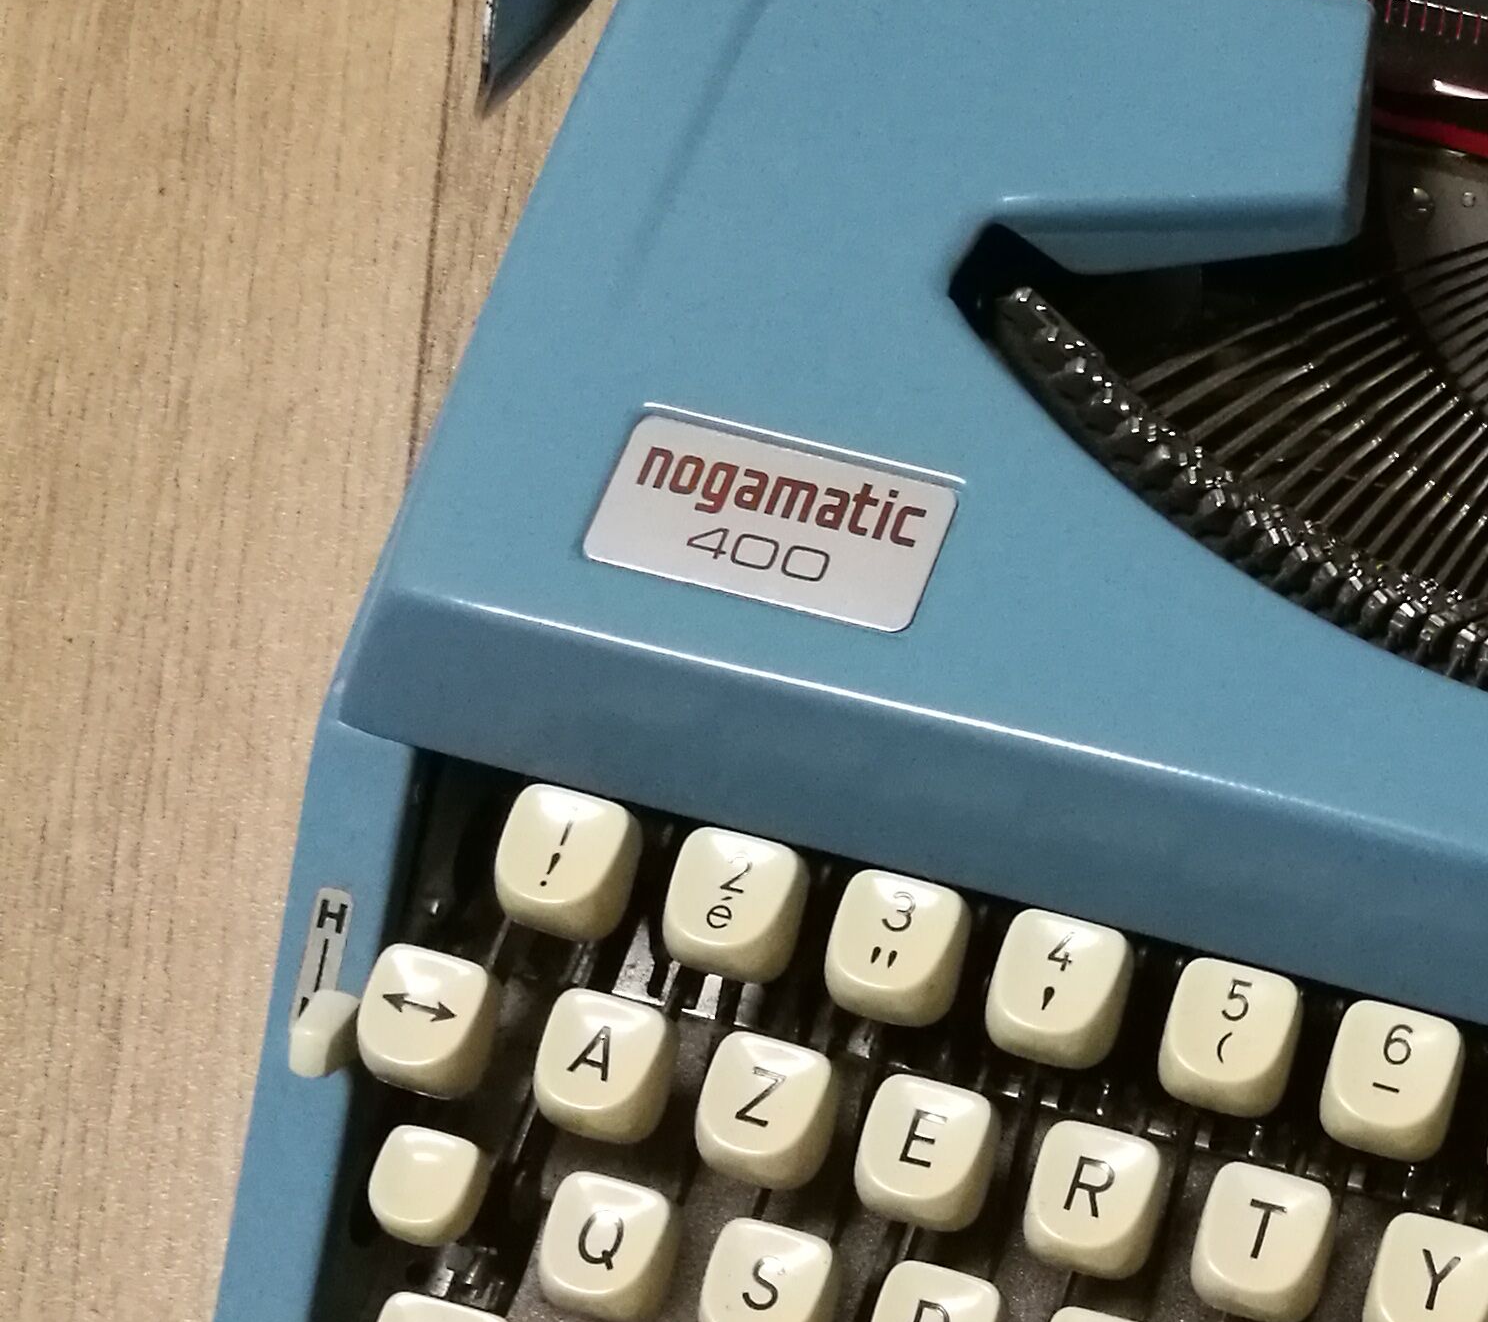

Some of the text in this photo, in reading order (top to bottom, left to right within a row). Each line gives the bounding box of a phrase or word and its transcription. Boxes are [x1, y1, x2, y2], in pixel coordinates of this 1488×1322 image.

[635, 445, 928, 549] nogamatic
[686, 526, 831, 583] 400
[539, 851, 561, 887] !
[718, 852, 754, 895] 2
[316, 898, 349, 934] H
[705, 895, 733, 929] é
[880, 891, 916, 933] 3
[1046, 931, 1076, 972] 4
[1220, 978, 1253, 1022] 5
[566, 1025, 612, 1083] A
[1215, 1031, 1234, 1065] (
[1382, 1023, 1415, 1066] 6
[734, 1065, 786, 1128] Z
[898, 1108, 949, 1169] E
[1062, 1155, 1116, 1219] R
[577, 1208, 626, 1272] Q
[1249, 1197, 1288, 1260] T
[741, 1255, 787, 1311] S
[1422, 1247, 1462, 1311] Y
